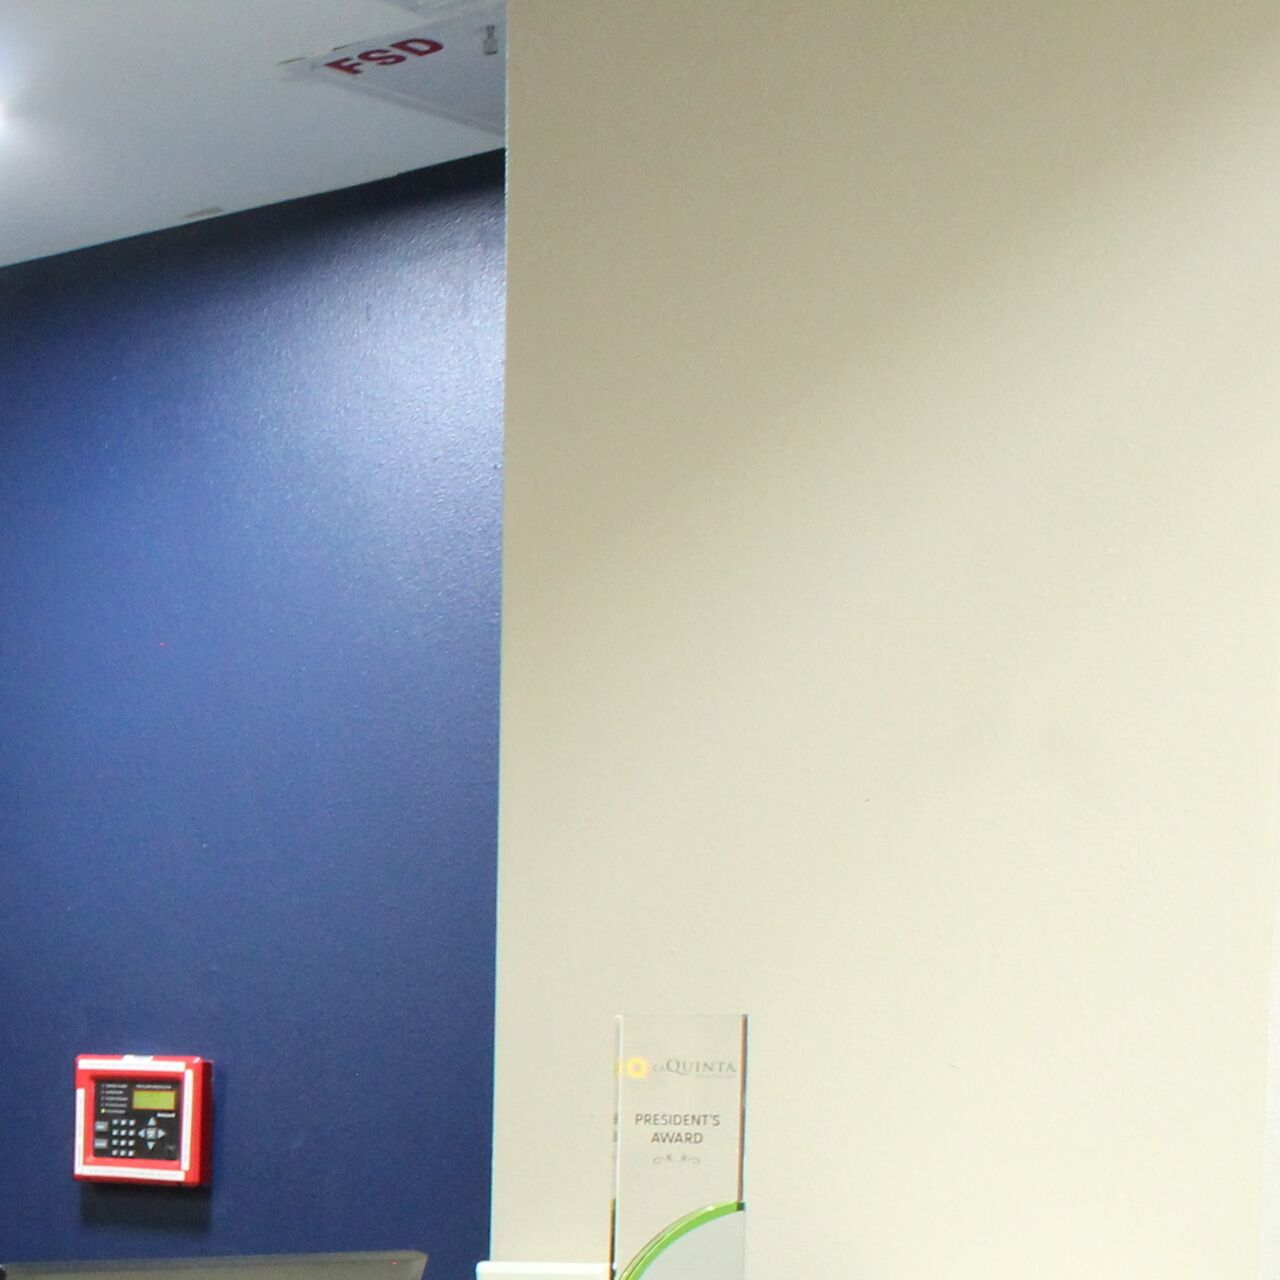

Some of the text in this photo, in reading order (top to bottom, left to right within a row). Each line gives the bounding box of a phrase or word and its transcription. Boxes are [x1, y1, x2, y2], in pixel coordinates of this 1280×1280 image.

[666, 1058, 738, 1076] QUINTA
[634, 1113, 721, 1127] PRESIDENT'S
[650, 1132, 704, 1144] AWARD
